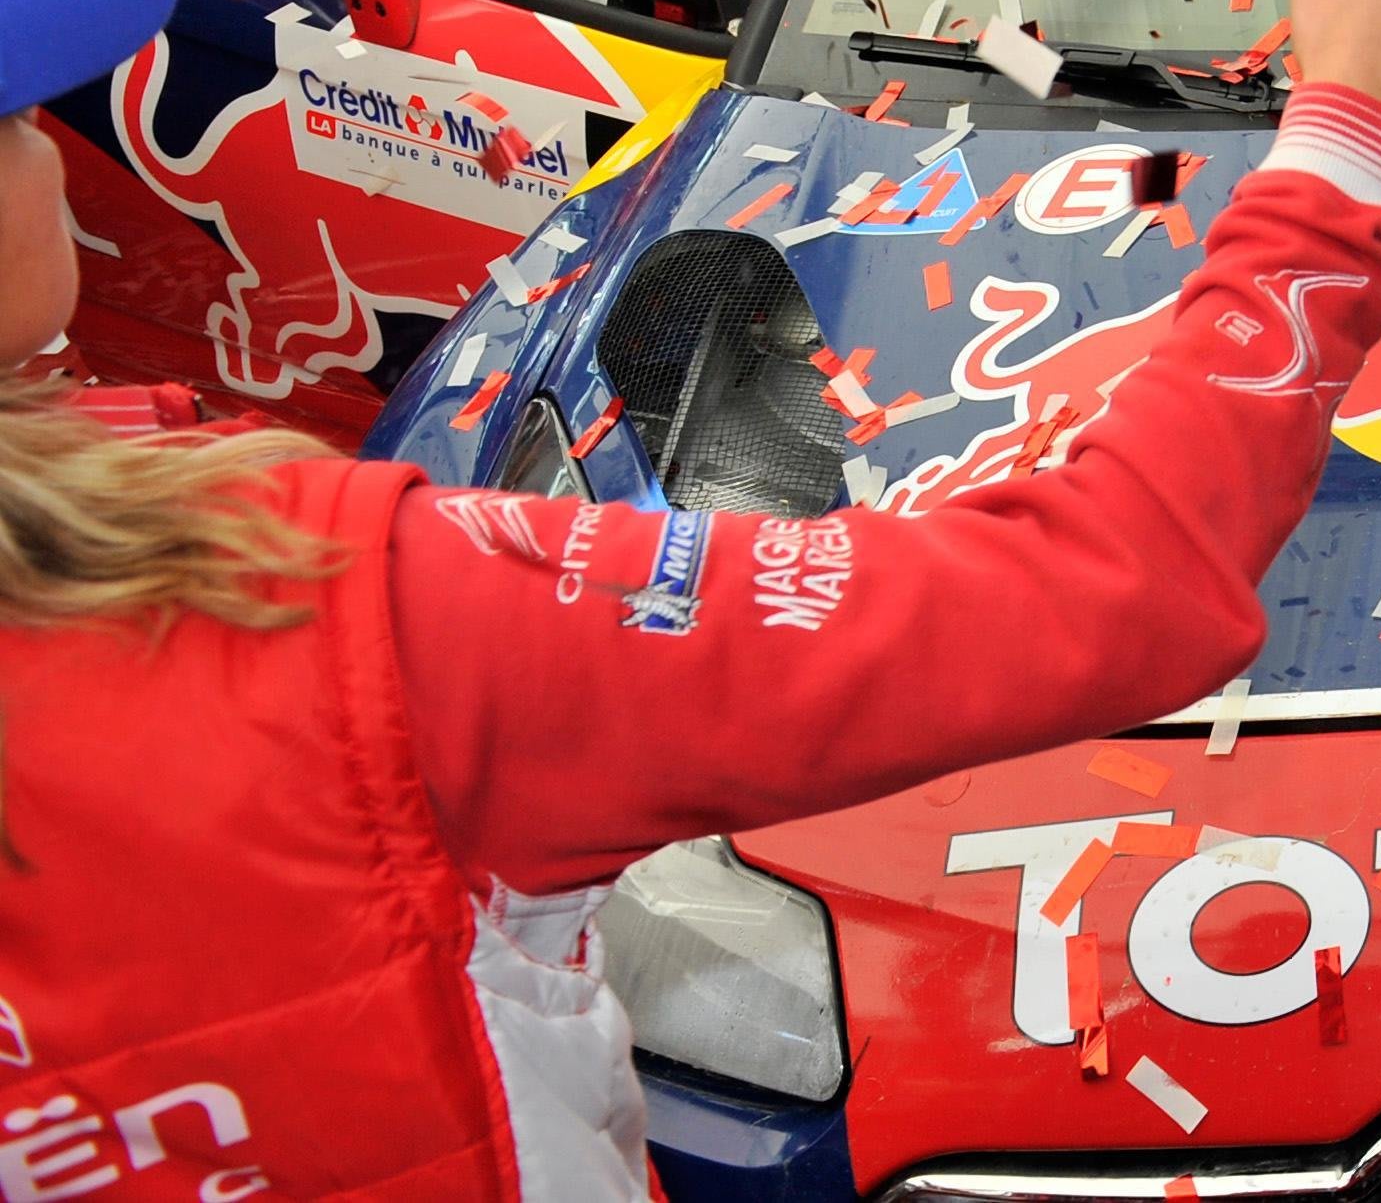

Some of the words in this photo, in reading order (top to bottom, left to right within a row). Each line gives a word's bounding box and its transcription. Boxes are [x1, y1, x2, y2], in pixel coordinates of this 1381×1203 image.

[299, 68, 403, 130] Crédit
[443, 109, 569, 177] Muel
[310, 115, 332, 134] LA
[341, 124, 420, 161] banque
[431, 150, 441, 167] à
[1040, 158, 1134, 220] E
[556, 500, 604, 605] CITRO
